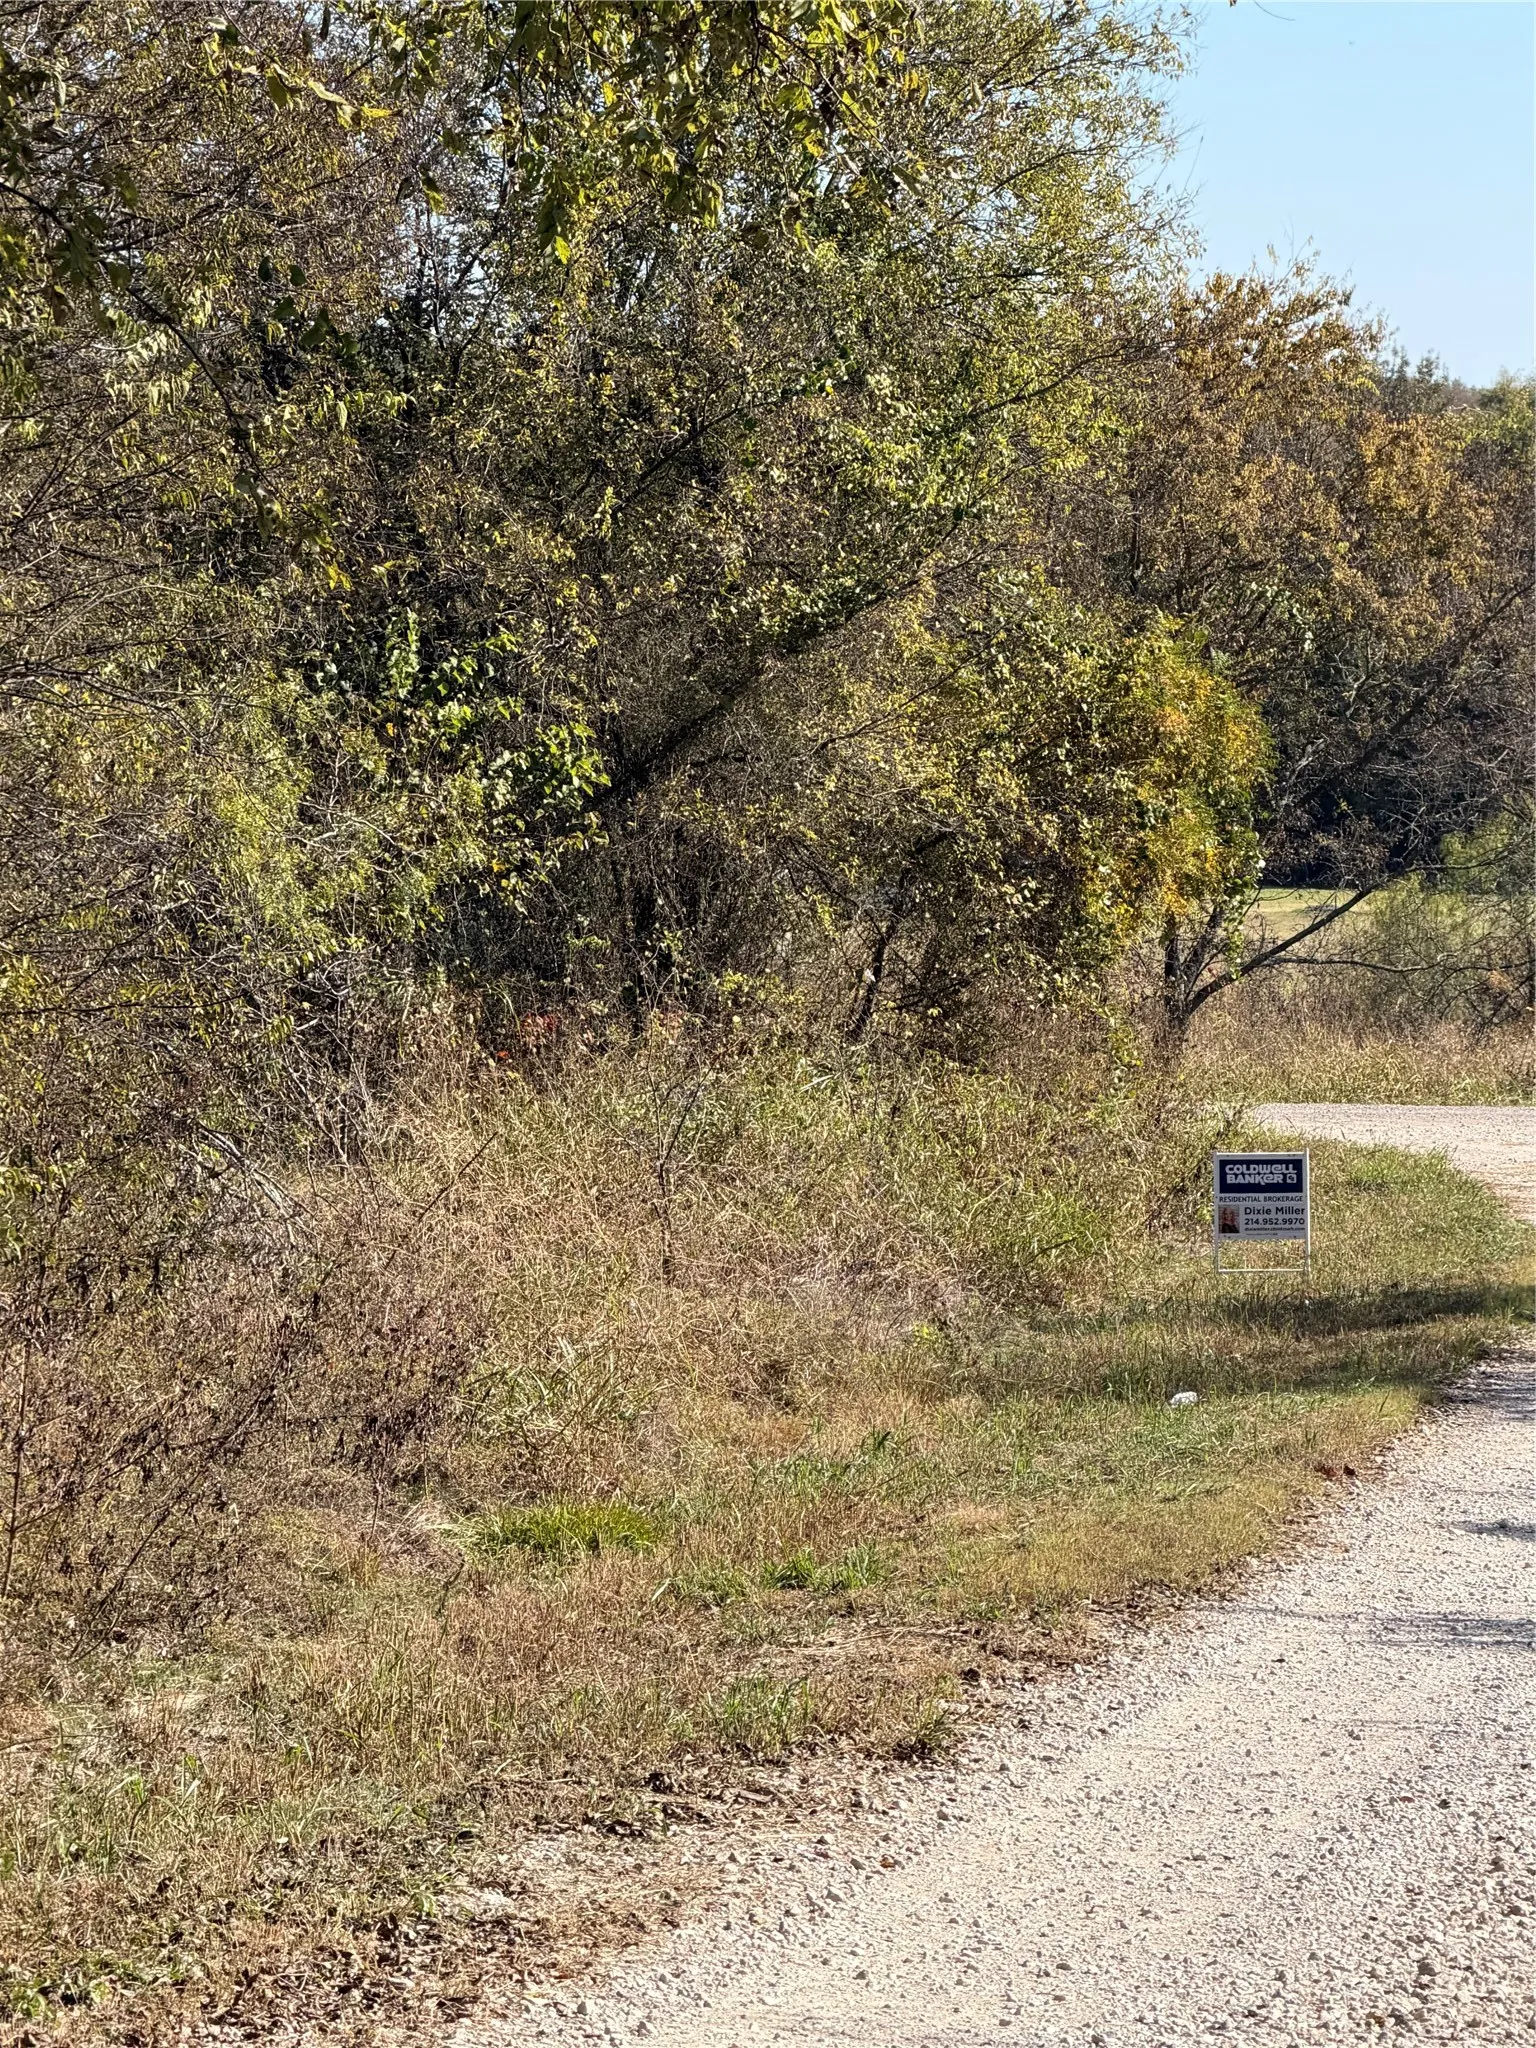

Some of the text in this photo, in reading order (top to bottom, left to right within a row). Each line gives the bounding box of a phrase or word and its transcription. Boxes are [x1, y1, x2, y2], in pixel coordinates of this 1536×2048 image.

[1225, 1164, 1297, 1174] COLDWELL
[1227, 1174, 1283, 1185] BANKER
[1244, 1206, 1305, 1215] Dixie Miller
[1244, 1218, 1305, 1226] 214.952.9970
